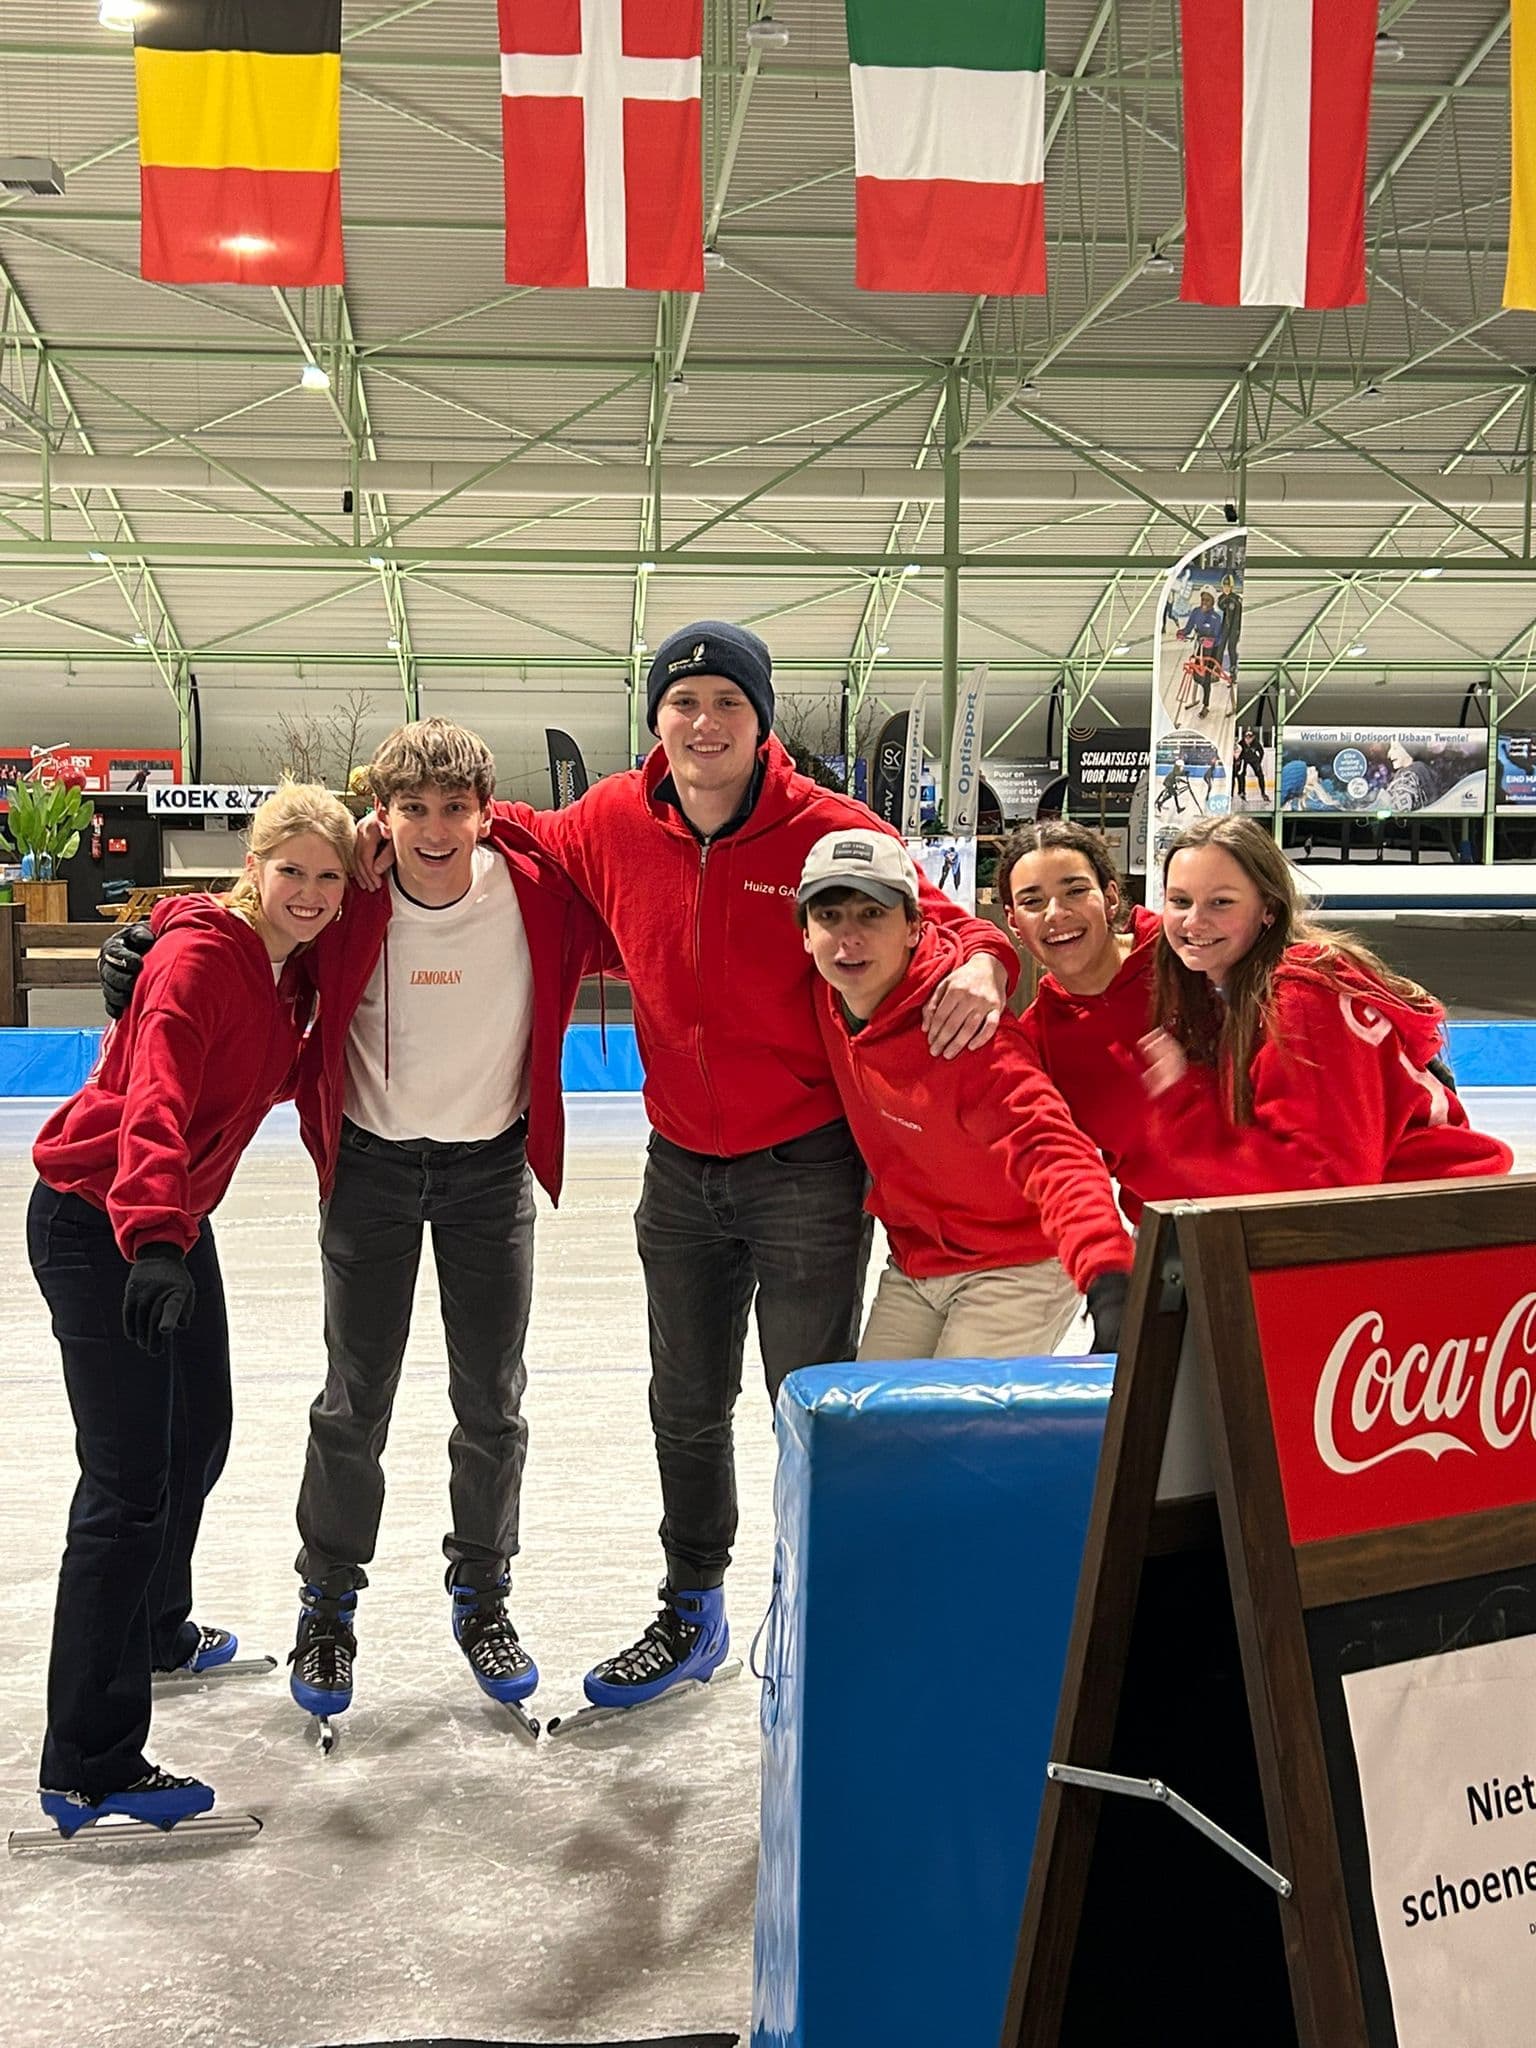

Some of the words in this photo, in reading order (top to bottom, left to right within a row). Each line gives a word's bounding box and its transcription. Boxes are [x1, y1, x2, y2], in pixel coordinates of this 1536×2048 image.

[958, 691, 977, 795] Optisport
[1301, 732, 1338, 741] Welkom
[1340, 732, 1352, 743] bij
[1354, 732, 1396, 743] Optisport
[1080, 752, 1138, 766] SCHAATSLES
[1081, 769, 1105, 783] VOOR
[1105, 769, 1129, 783] JONG
[1129, 769, 1138, 783] &
[155, 790, 219, 808] KOEK
[225, 790, 242, 808] &
[743, 879, 775, 895] Huize
[410, 970, 462, 985] LEMORAN
[1314, 1291, 1536, 1474] Coca-C
[1466, 1774, 1536, 1825] Niet
